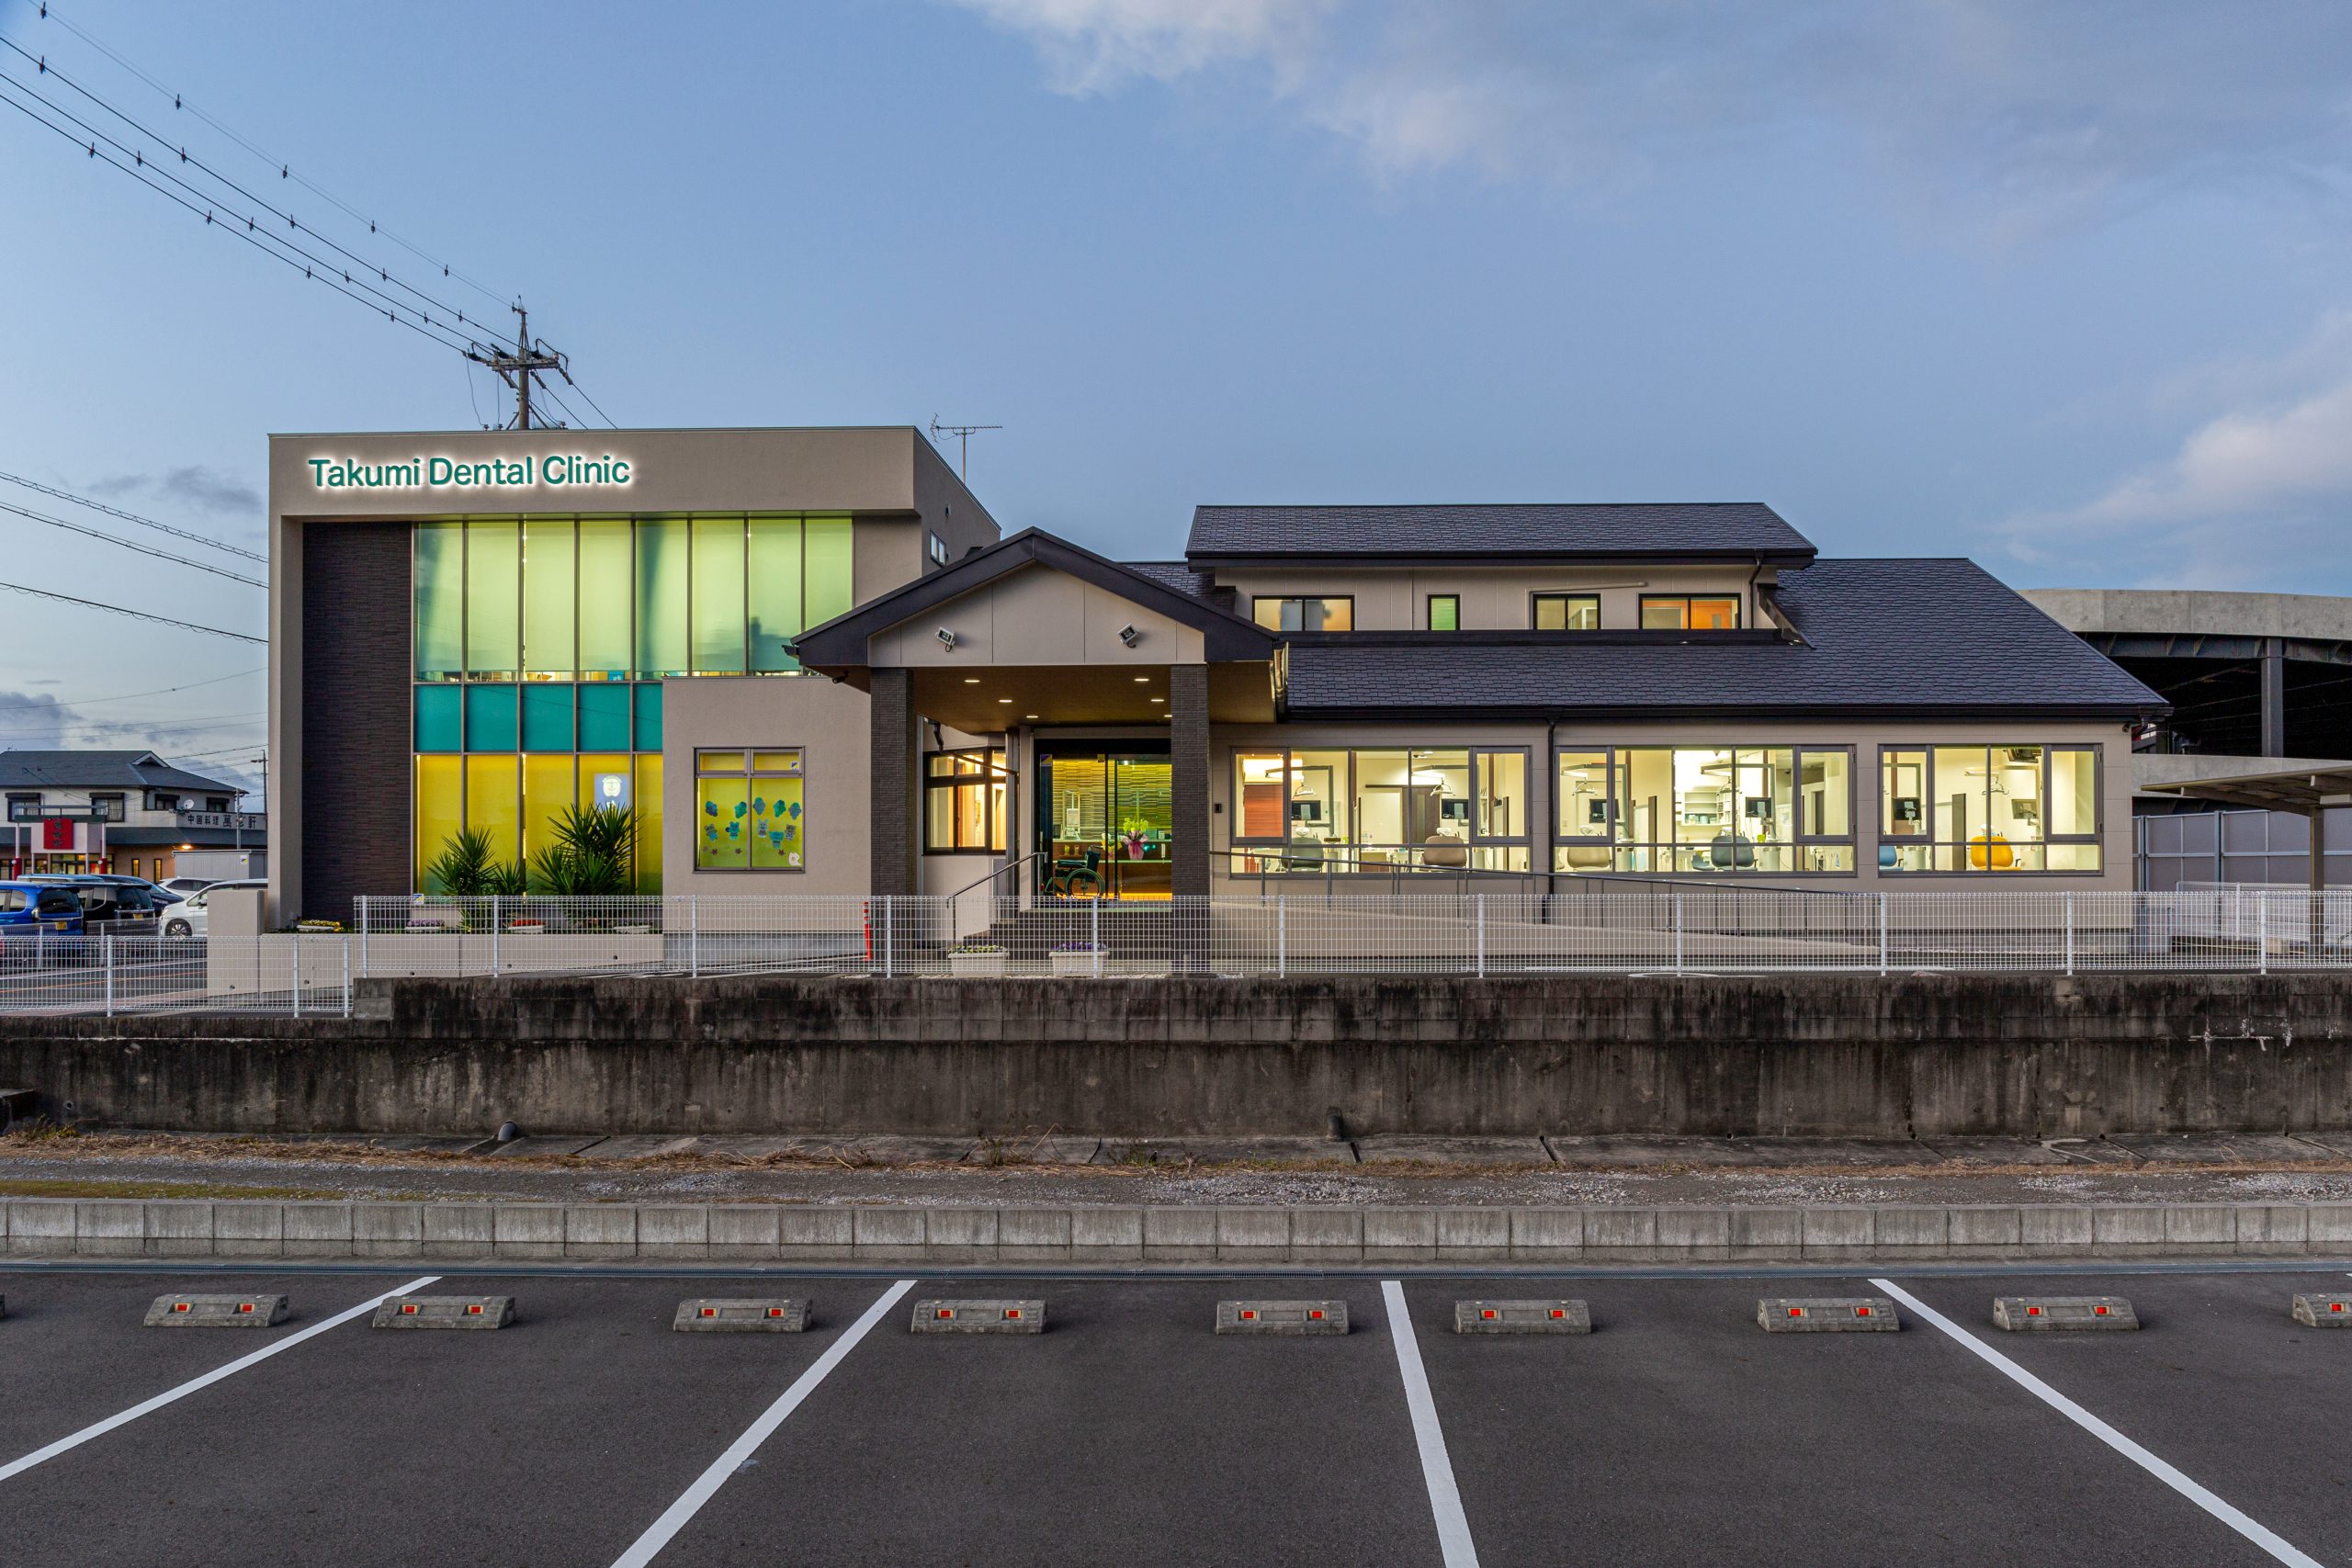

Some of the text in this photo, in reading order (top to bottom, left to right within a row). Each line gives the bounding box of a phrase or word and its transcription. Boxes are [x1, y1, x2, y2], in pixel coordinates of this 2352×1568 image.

[308, 456, 630, 487] Takumi Dental Clinic
